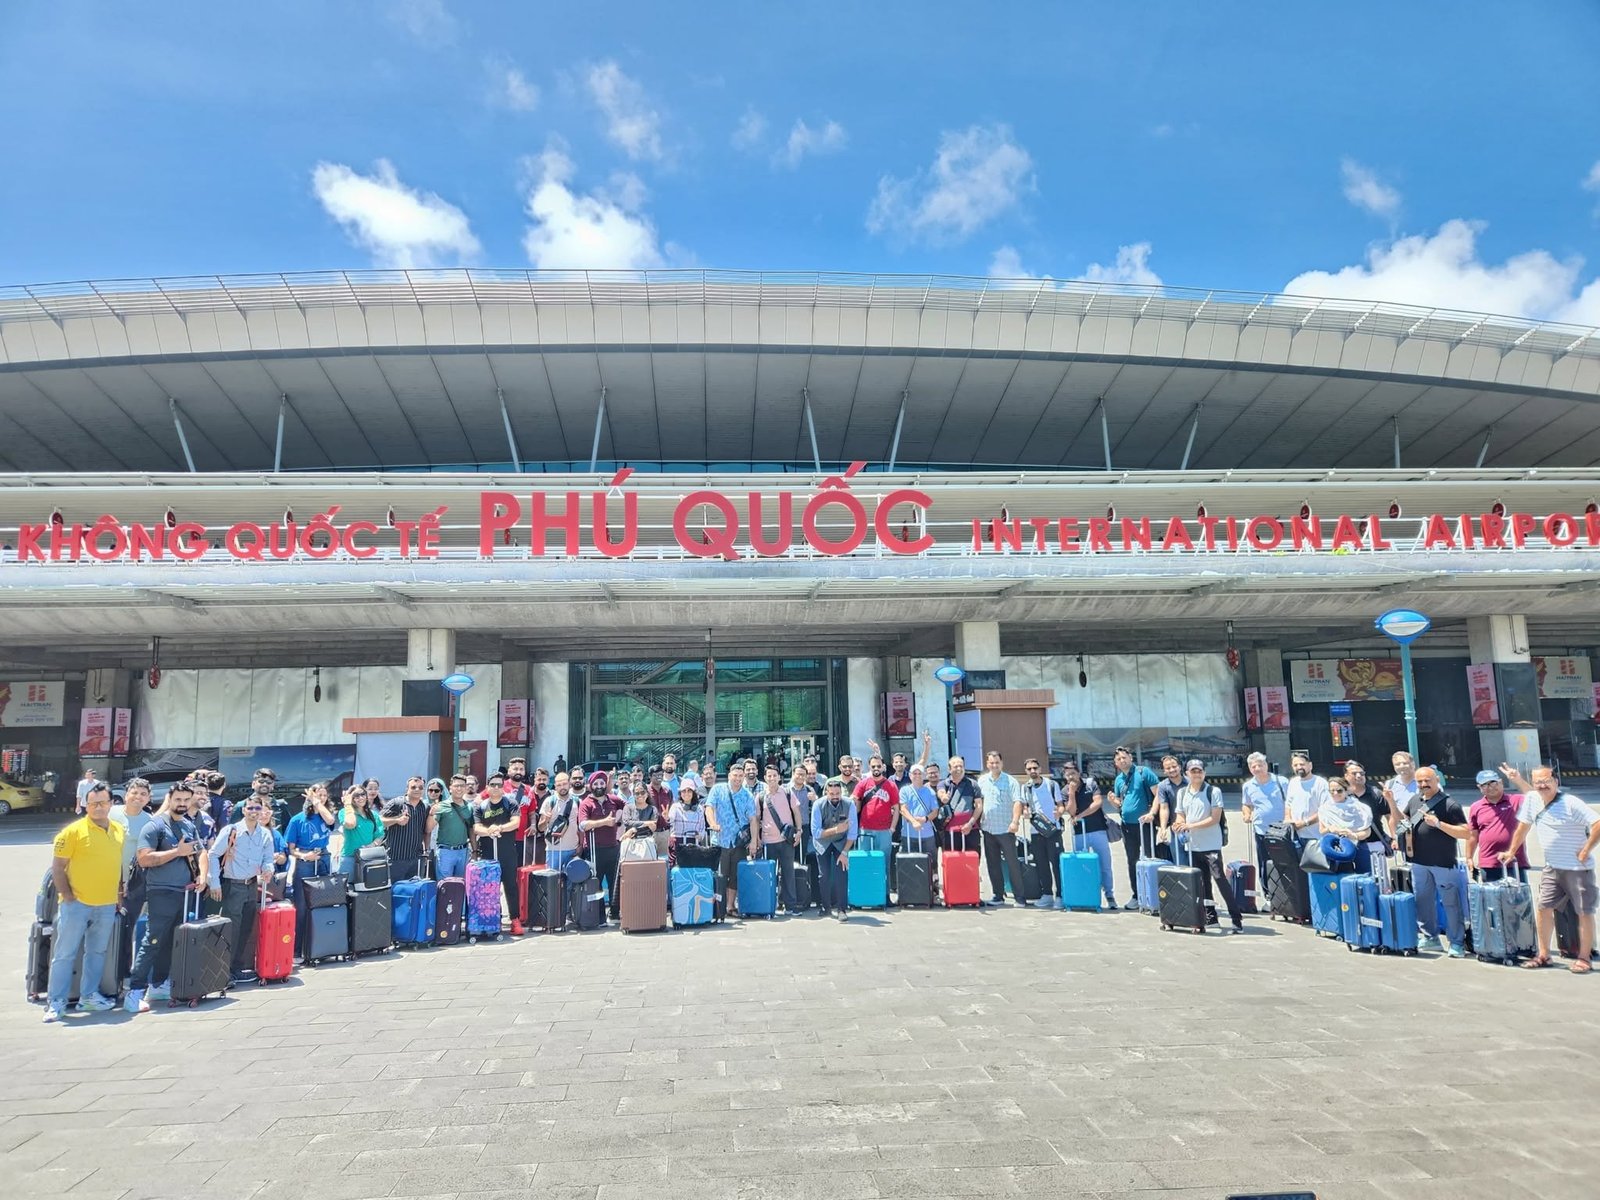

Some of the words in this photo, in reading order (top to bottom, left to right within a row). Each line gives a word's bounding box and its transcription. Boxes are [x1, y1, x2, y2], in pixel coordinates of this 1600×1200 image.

[17, 513, 210, 561] KHÔNG
[225, 505, 380, 561] QUỐC
[394, 505, 448, 557] TẾ
[479, 468, 639, 557] PHÚ
[672, 460, 935, 560] QUỐC
[972, 515, 1392, 552] INTERNATIONAL
